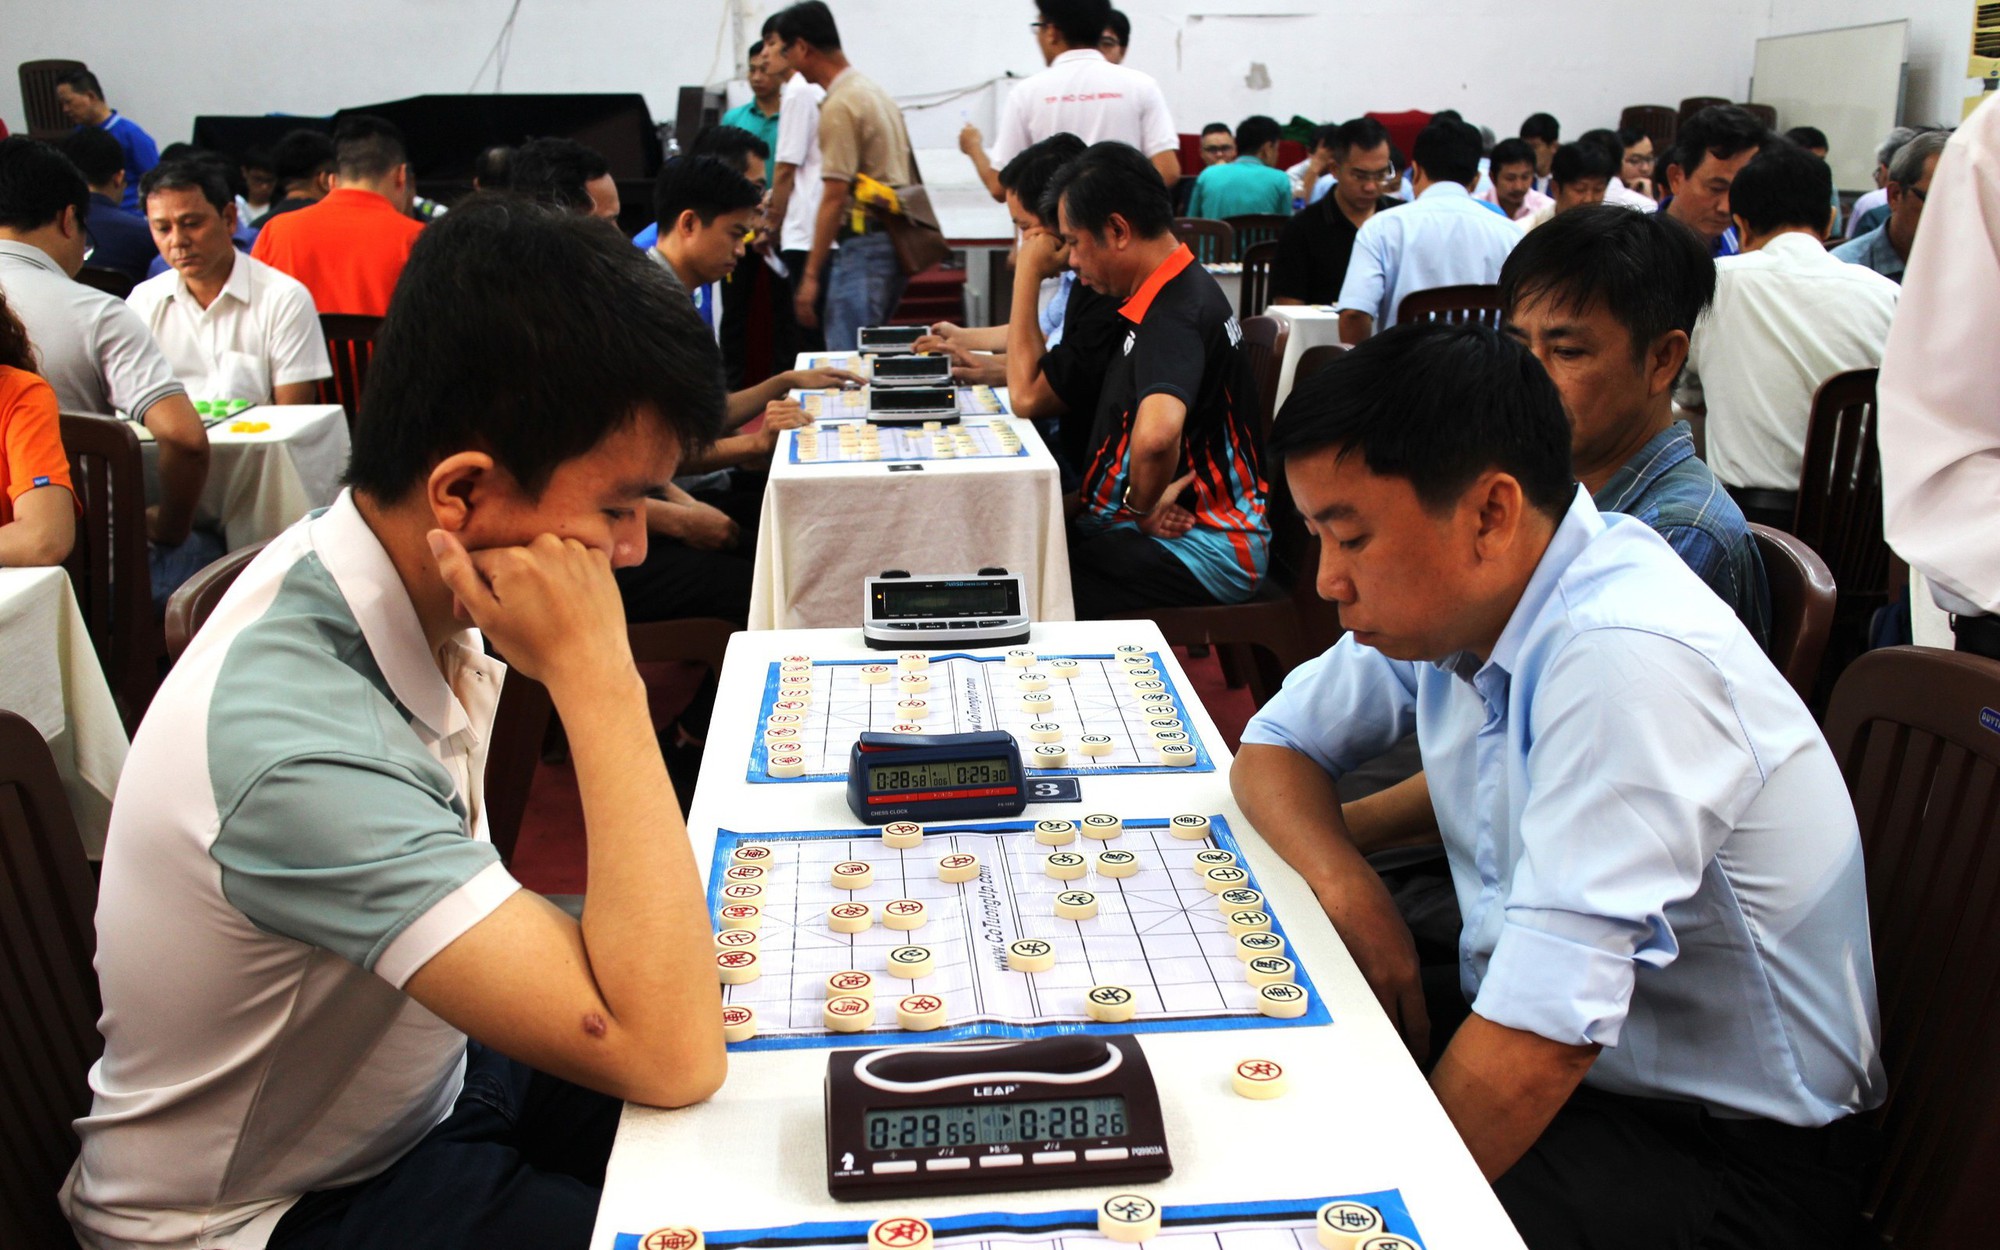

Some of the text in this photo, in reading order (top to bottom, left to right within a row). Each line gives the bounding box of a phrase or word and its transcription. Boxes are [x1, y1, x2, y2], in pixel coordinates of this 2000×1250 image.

[877, 773, 909, 789] 0:28
[912, 774, 927, 788] 58
[957, 767, 989, 784] 0:29
[992, 769, 1007, 782] 30
[1035, 783, 1060, 797] 3
[974, 1085, 1015, 1097] LEAP
[870, 1114, 940, 1149] 0:29
[1020, 1106, 1088, 1140] 0:28
[1095, 1113, 1124, 1136] 26
